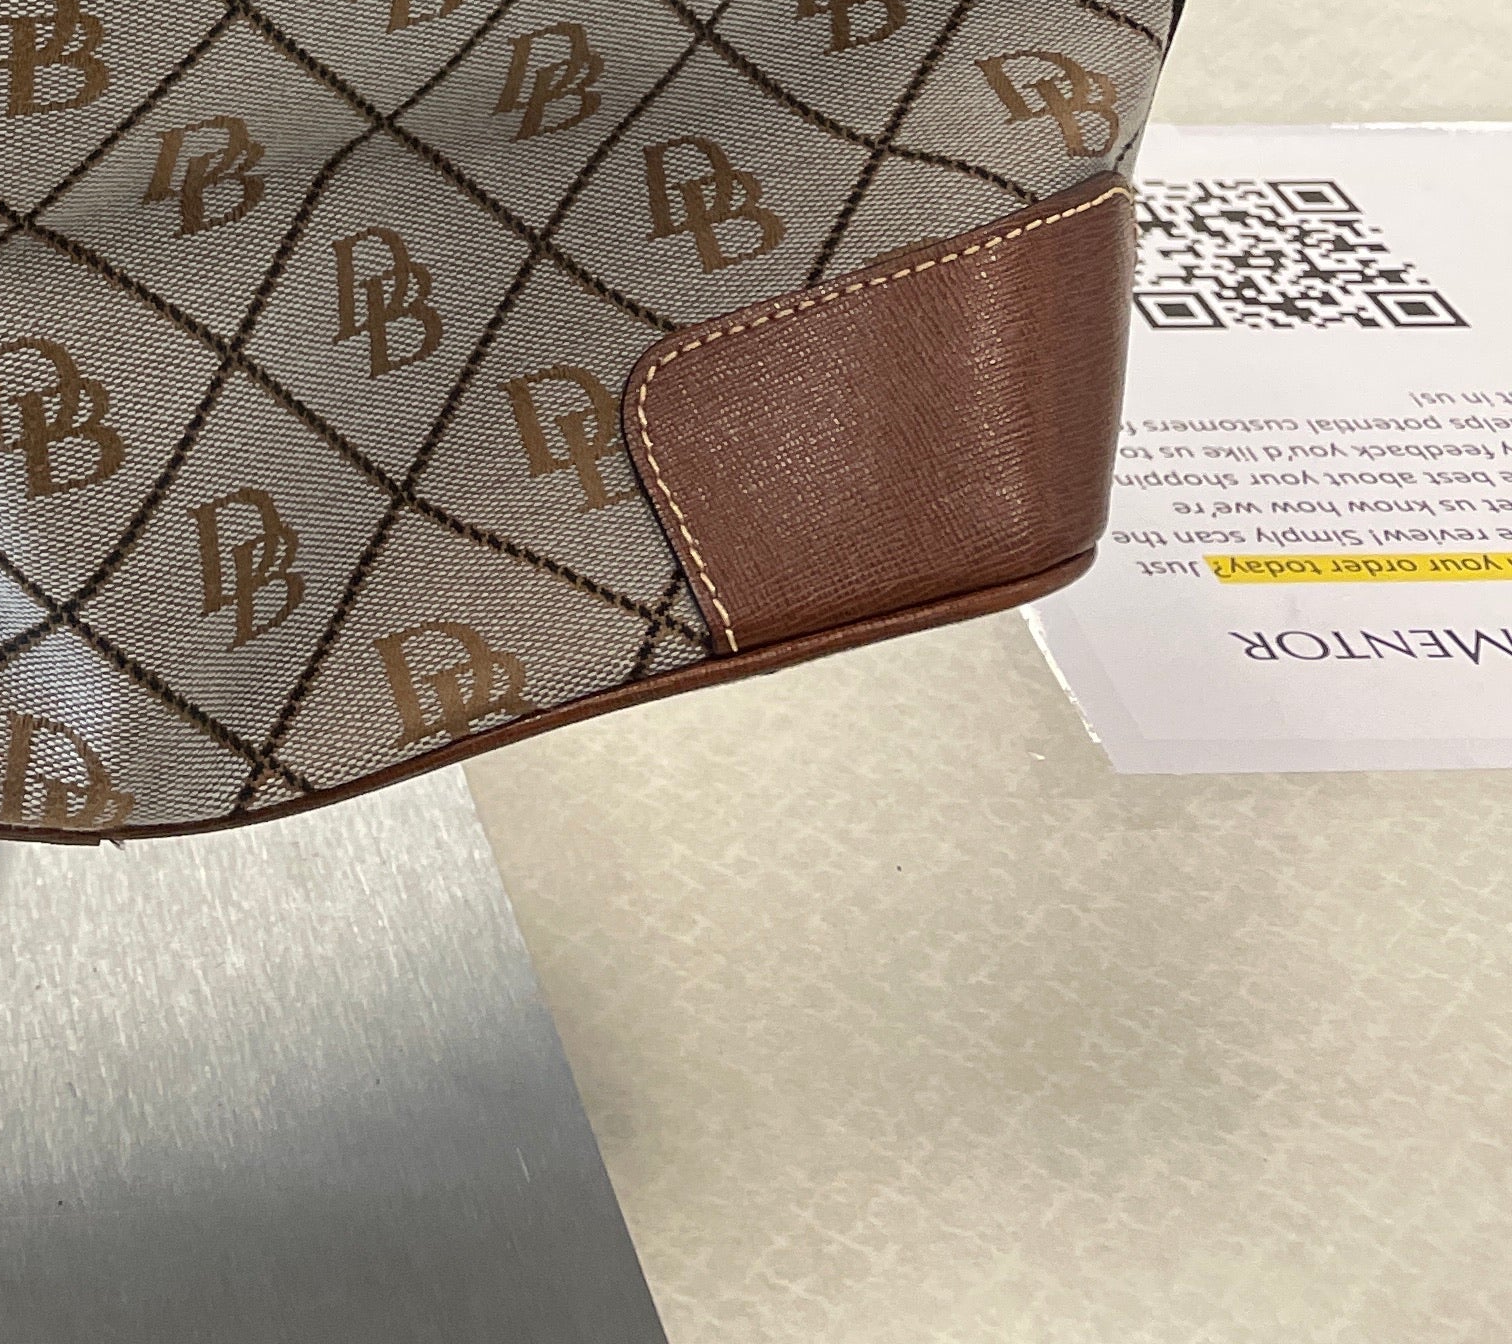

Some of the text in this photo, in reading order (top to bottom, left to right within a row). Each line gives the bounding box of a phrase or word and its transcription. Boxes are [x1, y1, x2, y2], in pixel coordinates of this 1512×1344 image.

[1408, 391, 1456, 408] us!
[1461, 392, 1495, 407] in
[1142, 419, 1298, 434] customers
[1306, 415, 1442, 435] potential
[1449, 415, 1512, 432] elps
[1120, 447, 1153, 460] to
[1159, 446, 1194, 458] us
[1203, 445, 1258, 462] like
[1262, 443, 1348, 462] you'd
[1350, 444, 1495, 461] feedback
[1113, 470, 1239, 490] shoppin
[1248, 470, 1320, 484] your
[1323, 472, 1417, 488] about
[1422, 471, 1496, 488] best
[1172, 499, 1512, 518] et us know how we're
[1111, 530, 1167, 548] the
[1174, 530, 1246, 543] scan
[1256, 527, 1363, 547] Simply
[1368, 528, 1489, 546] review!
[1136, 561, 1200, 577] Just
[1214, 557, 1321, 578] today?
[1330, 559, 1417, 576] order
[1429, 555, 1502, 573] your
[1228, 628, 1512, 665] MENTOR
